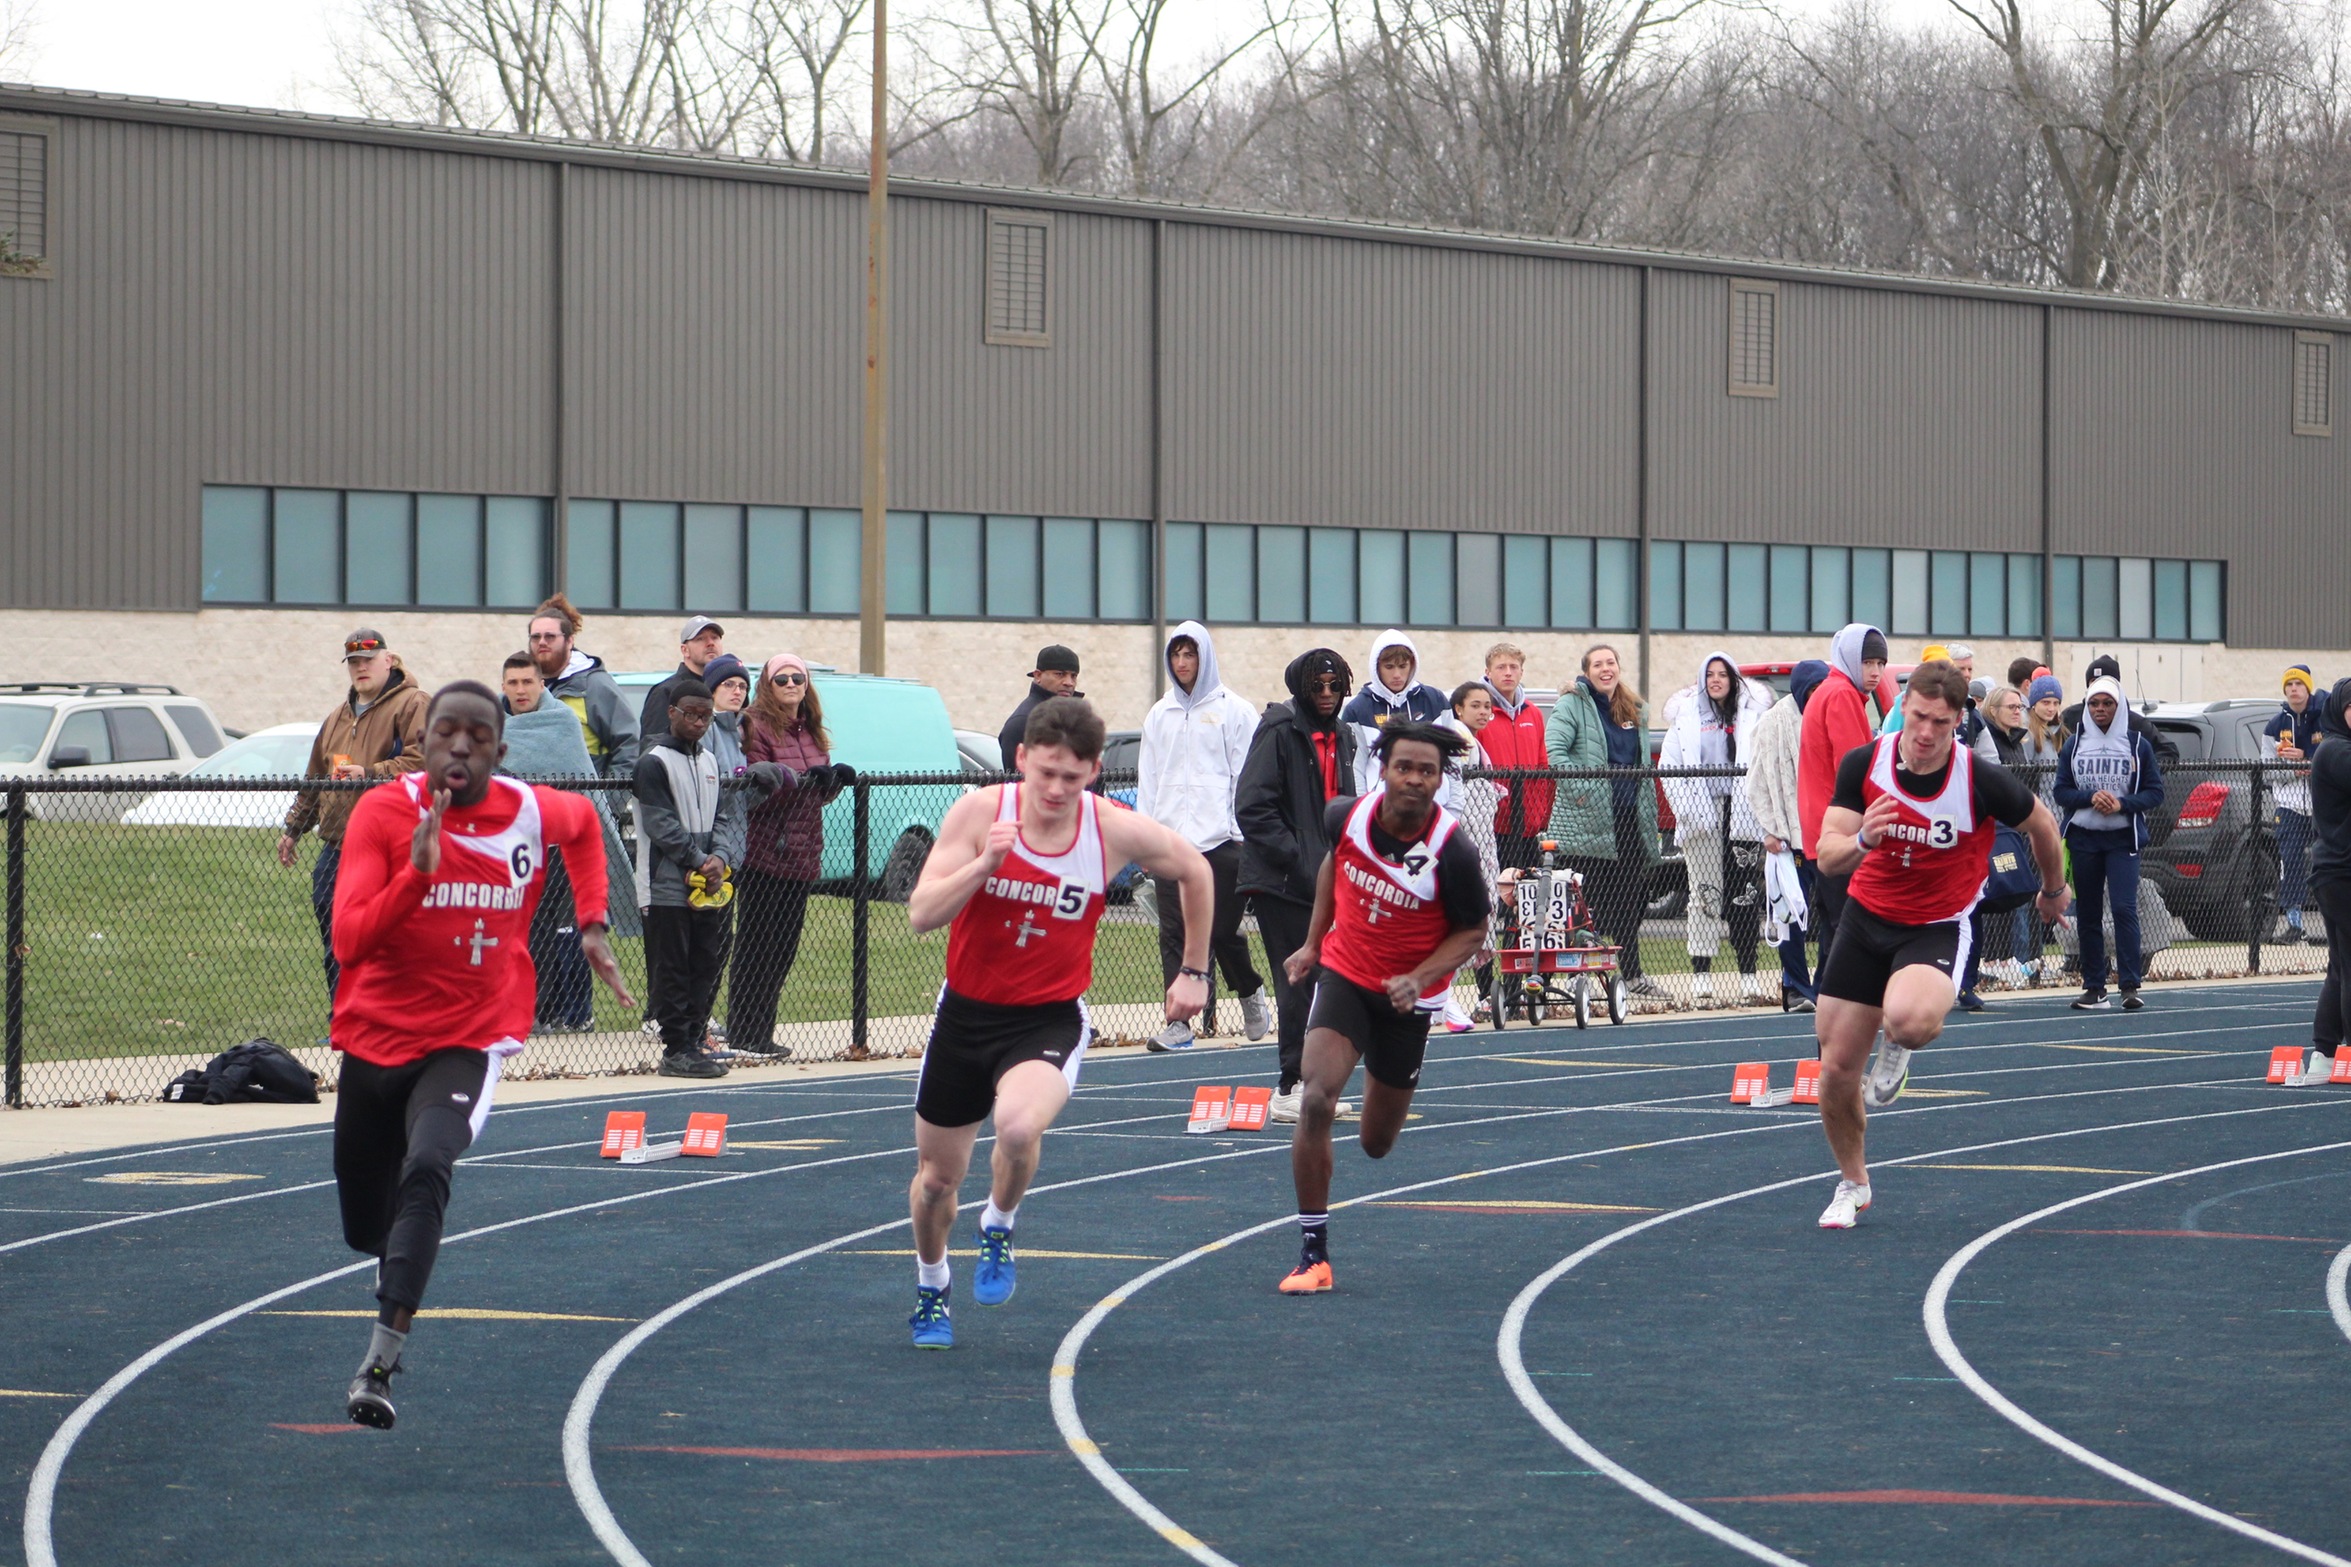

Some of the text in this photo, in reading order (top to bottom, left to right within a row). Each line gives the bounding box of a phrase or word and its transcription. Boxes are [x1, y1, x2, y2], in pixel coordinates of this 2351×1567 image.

[2077, 758, 2131, 775] SAINTS
[2098, 774, 2129, 784] HEIGHTS
[1934, 820, 1953, 844] 3
[512, 843, 531, 879] 6
[1404, 855, 1429, 876] 4
[985, 876, 1058, 907] CONCOR
[1058, 884, 1085, 914] 5
[1343, 861, 1420, 910] CONCORDIA
